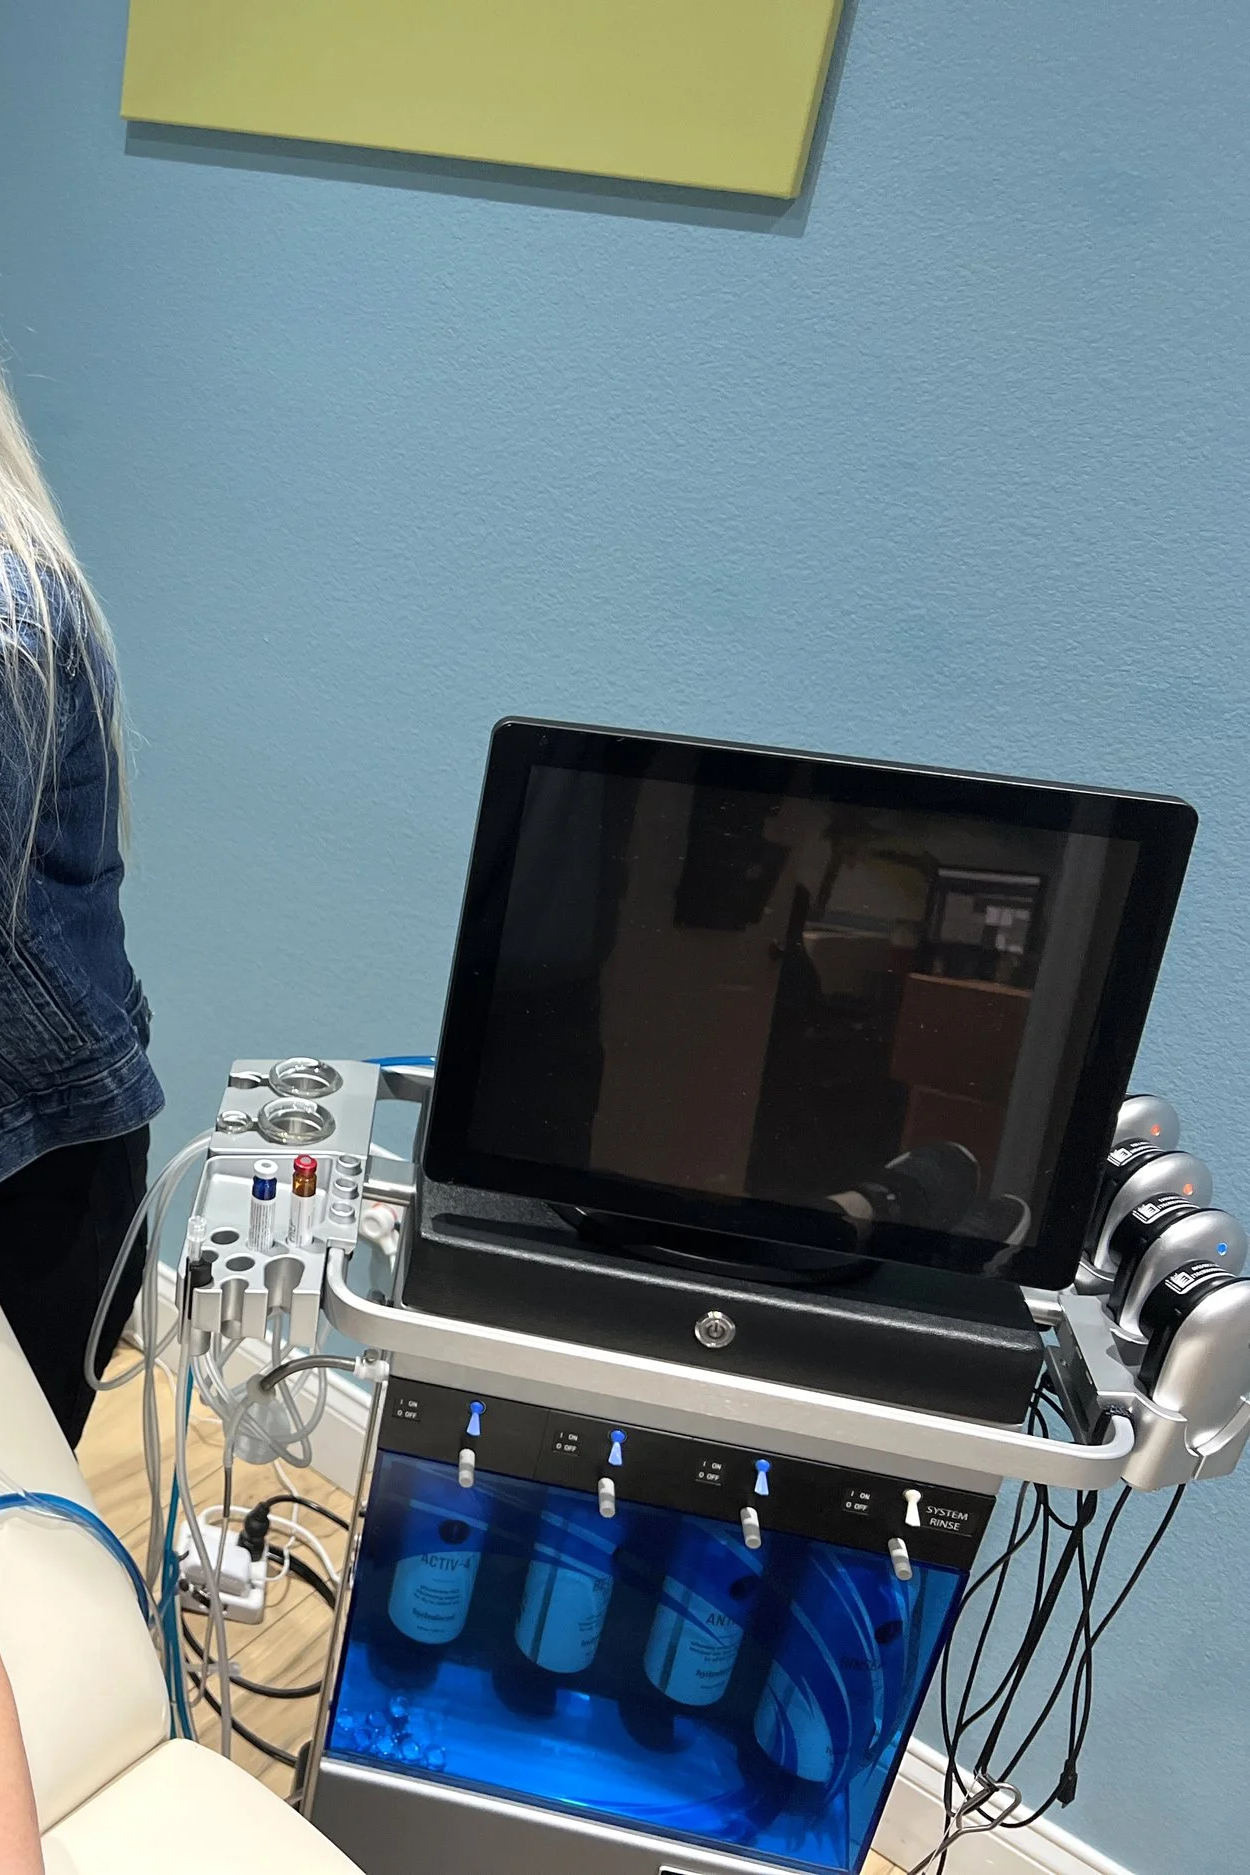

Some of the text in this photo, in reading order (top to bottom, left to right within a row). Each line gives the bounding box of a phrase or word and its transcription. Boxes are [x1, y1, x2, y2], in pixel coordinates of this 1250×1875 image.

[568, 1433, 579, 1442] ON
[563, 1444, 577, 1452] OFF
[711, 1462, 722, 1470] ON
[706, 1472, 720, 1481] OFF
[859, 1492, 871, 1500] ON
[853, 1503, 868, 1511] OFF
[926, 1505, 969, 1521] SYSTEM
[930, 1517, 961, 1531] RINSE
